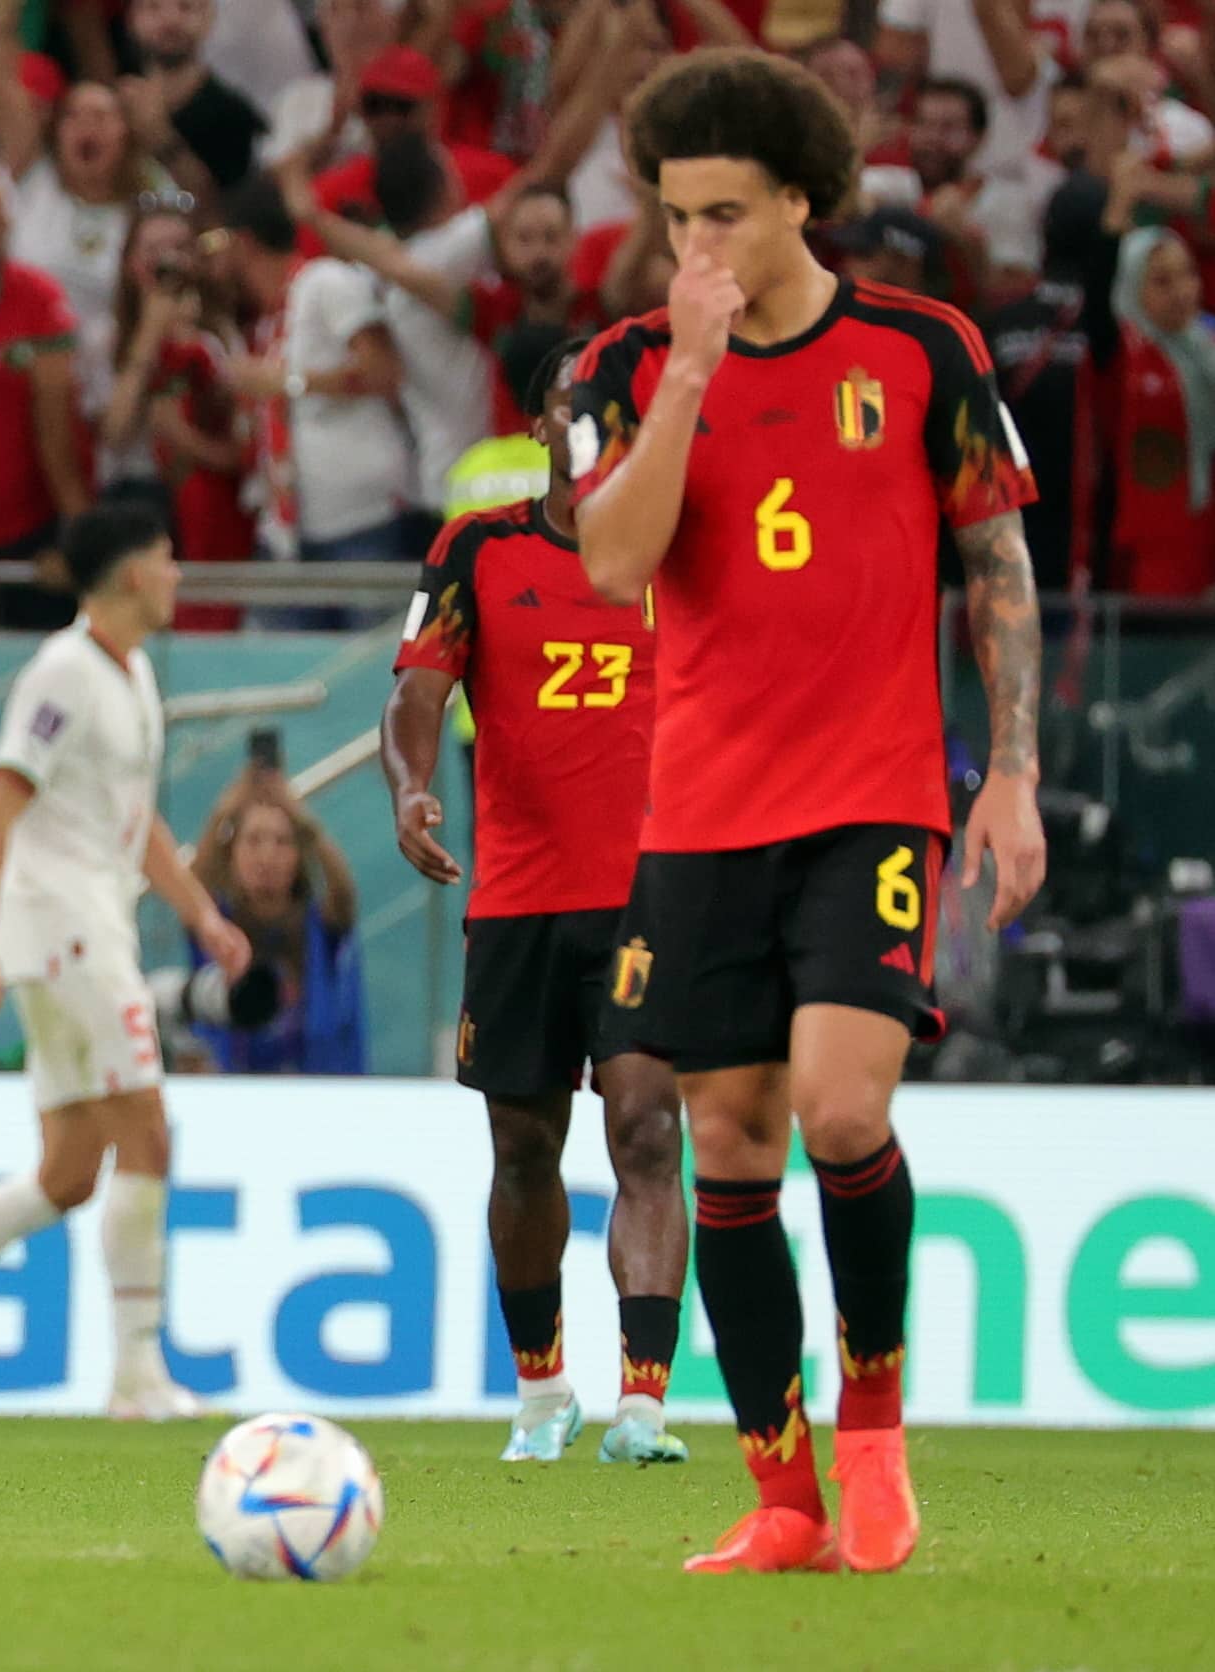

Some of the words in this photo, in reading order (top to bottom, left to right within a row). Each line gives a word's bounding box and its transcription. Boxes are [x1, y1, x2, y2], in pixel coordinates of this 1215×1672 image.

[756, 478, 811, 570] 6
[537, 641, 632, 709] 23
[876, 845, 920, 930] 6
